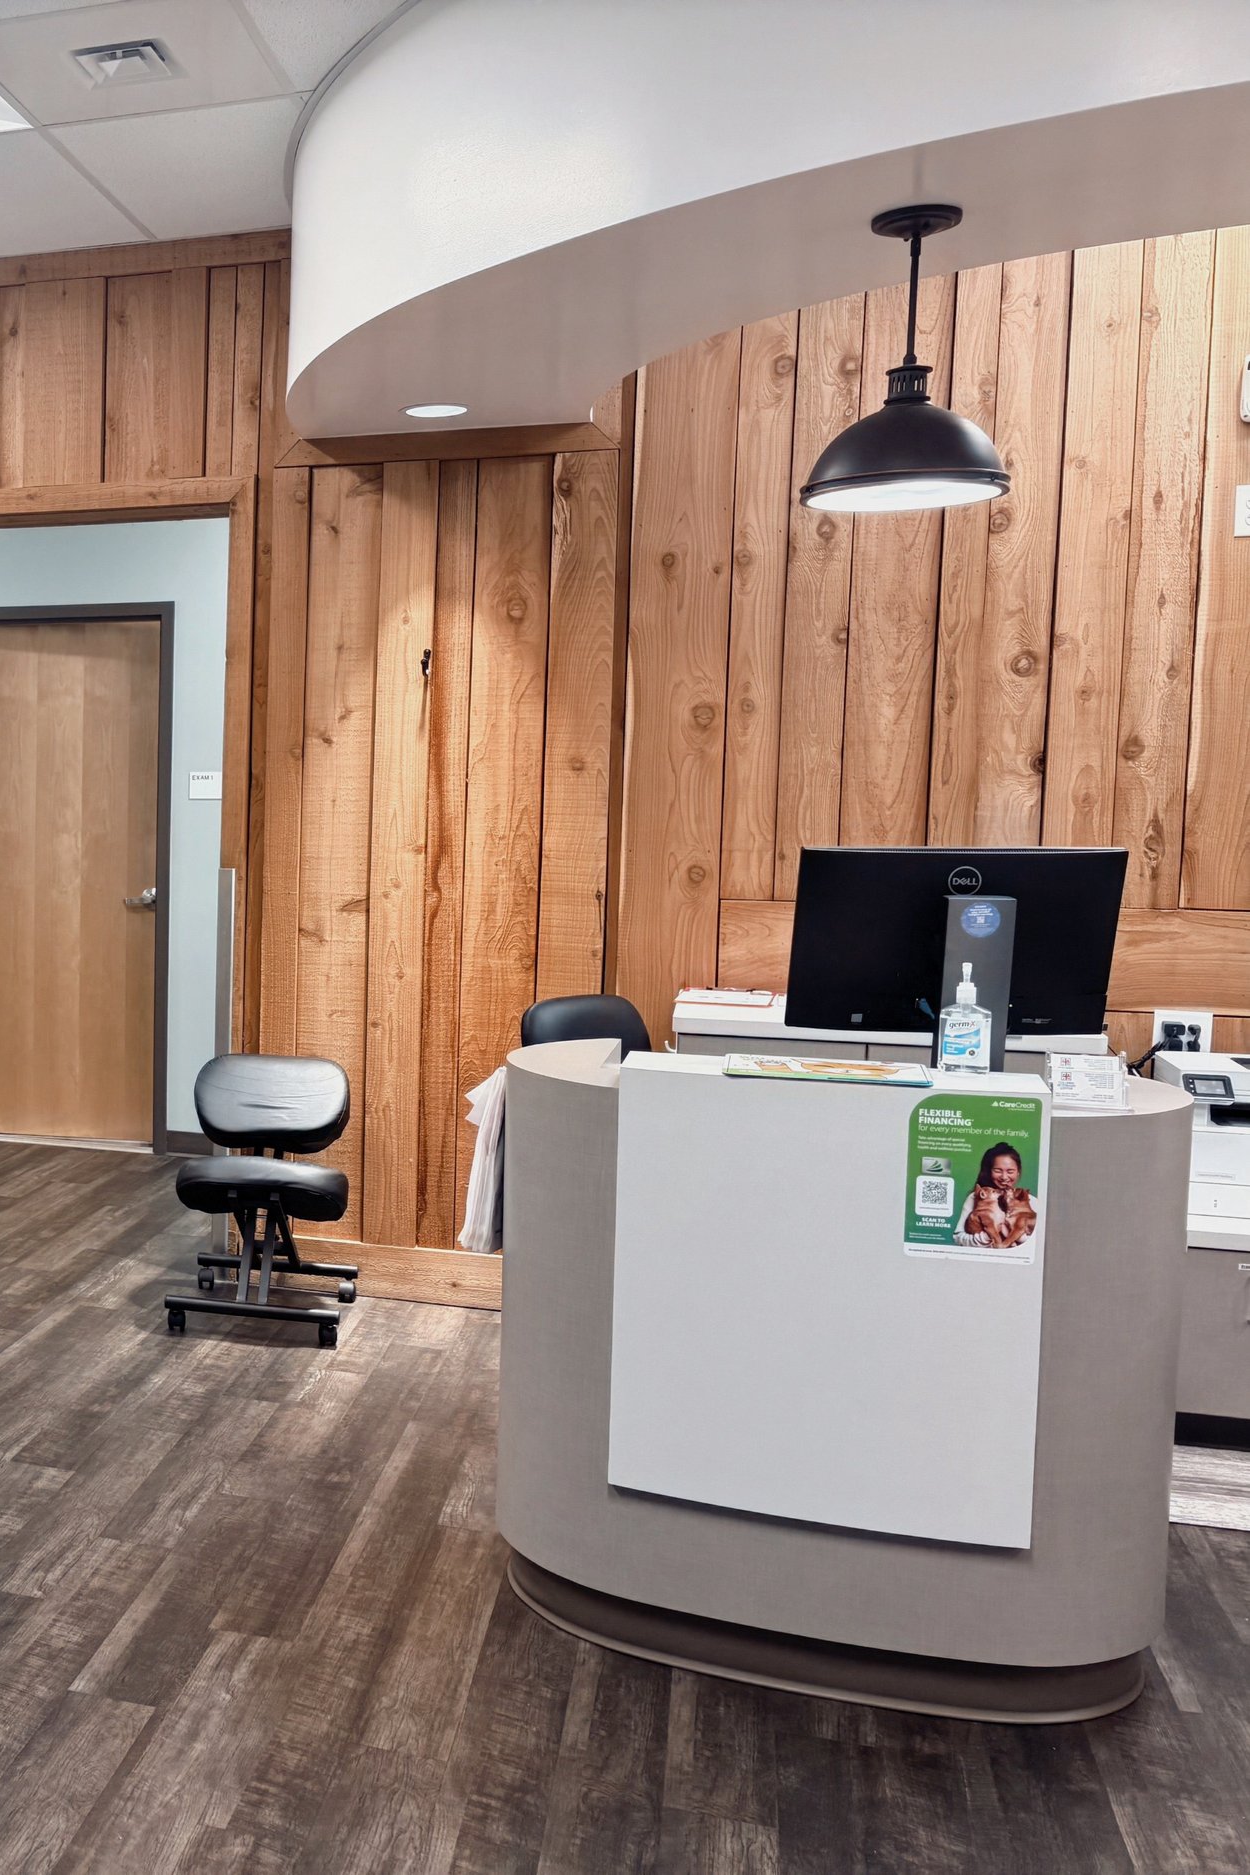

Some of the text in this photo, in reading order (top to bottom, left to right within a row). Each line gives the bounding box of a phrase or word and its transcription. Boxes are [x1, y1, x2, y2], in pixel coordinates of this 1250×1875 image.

[952, 877, 978, 886] DELL
[919, 1108, 962, 1118] FLEXIBLE
[930, 1126, 950, 1134] every
[951, 1127, 982, 1135] member
[984, 1127, 992, 1135] of
[993, 1128, 1005, 1136] the
[1007, 1129, 1029, 1138] family.
